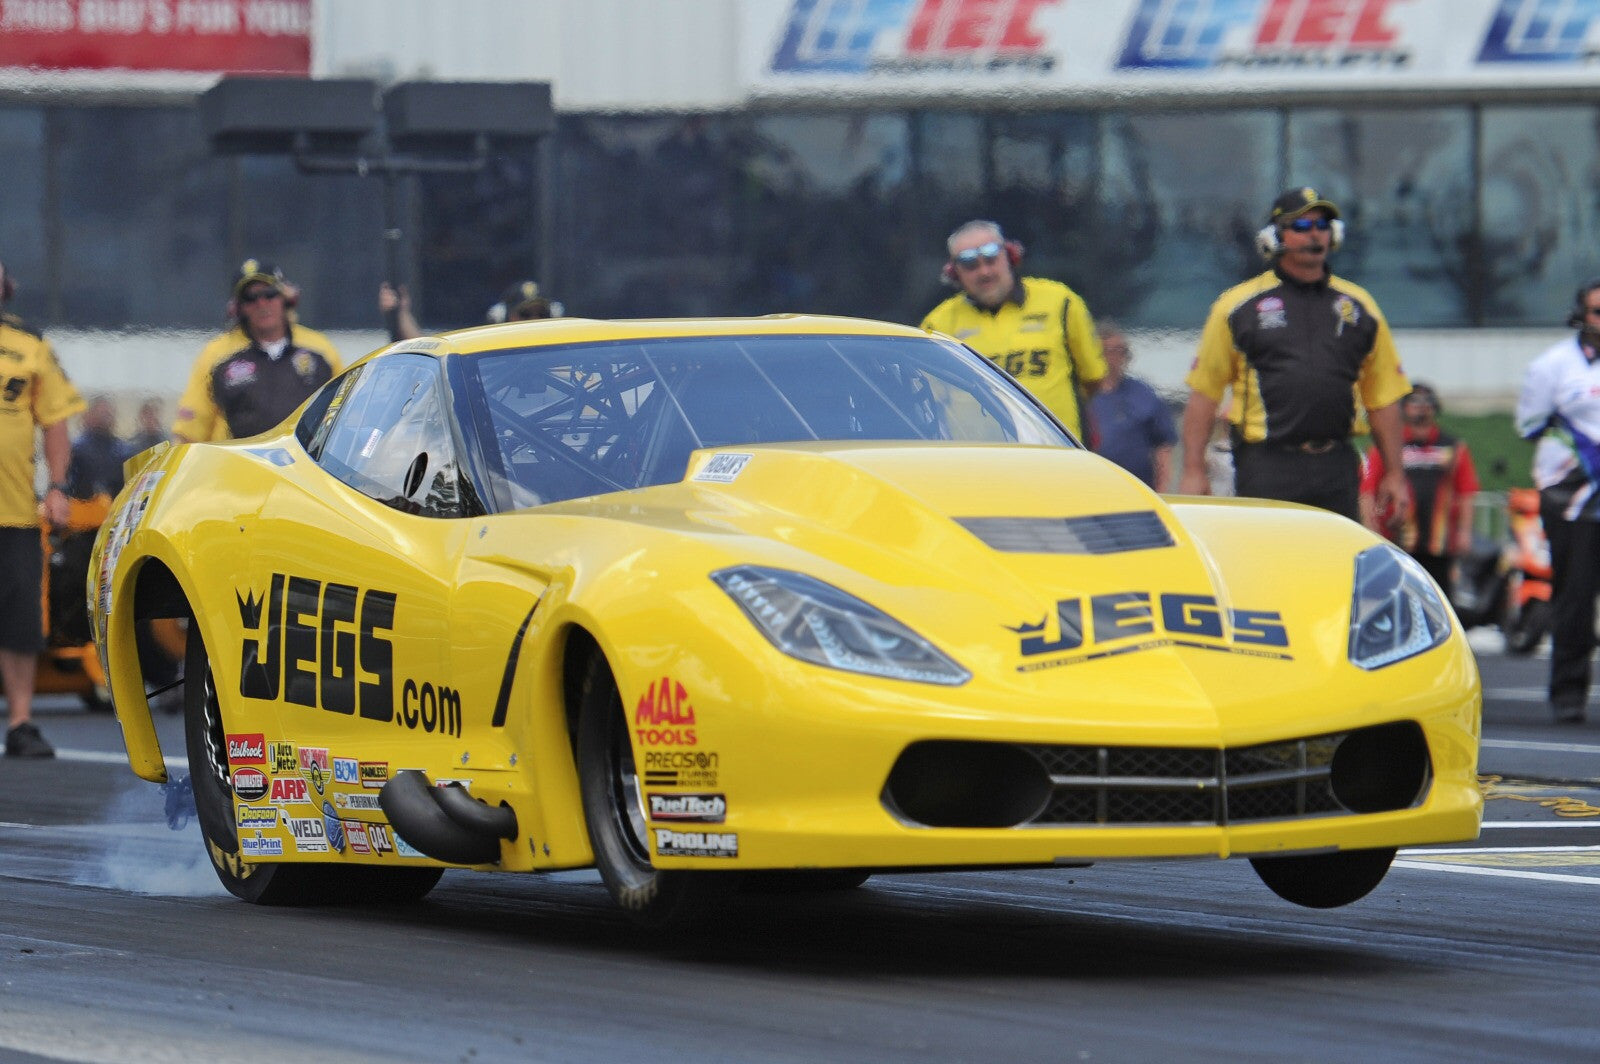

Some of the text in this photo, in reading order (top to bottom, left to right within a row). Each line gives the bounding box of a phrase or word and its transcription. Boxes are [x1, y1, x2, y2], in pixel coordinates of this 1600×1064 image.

[1020, 592, 1290, 657] JEGS
[239, 572, 462, 739] JEGS.com
[635, 677, 695, 725] MAC
[637, 729, 697, 746] TOOLS
[229, 740, 263, 758] Edelbrock
[271, 780, 307, 799] ARP
[651, 796, 725, 812] FuelTech
[291, 820, 324, 838] WELD
[242, 839, 281, 849] Blue Print
[656, 829, 737, 850] PROLINE
